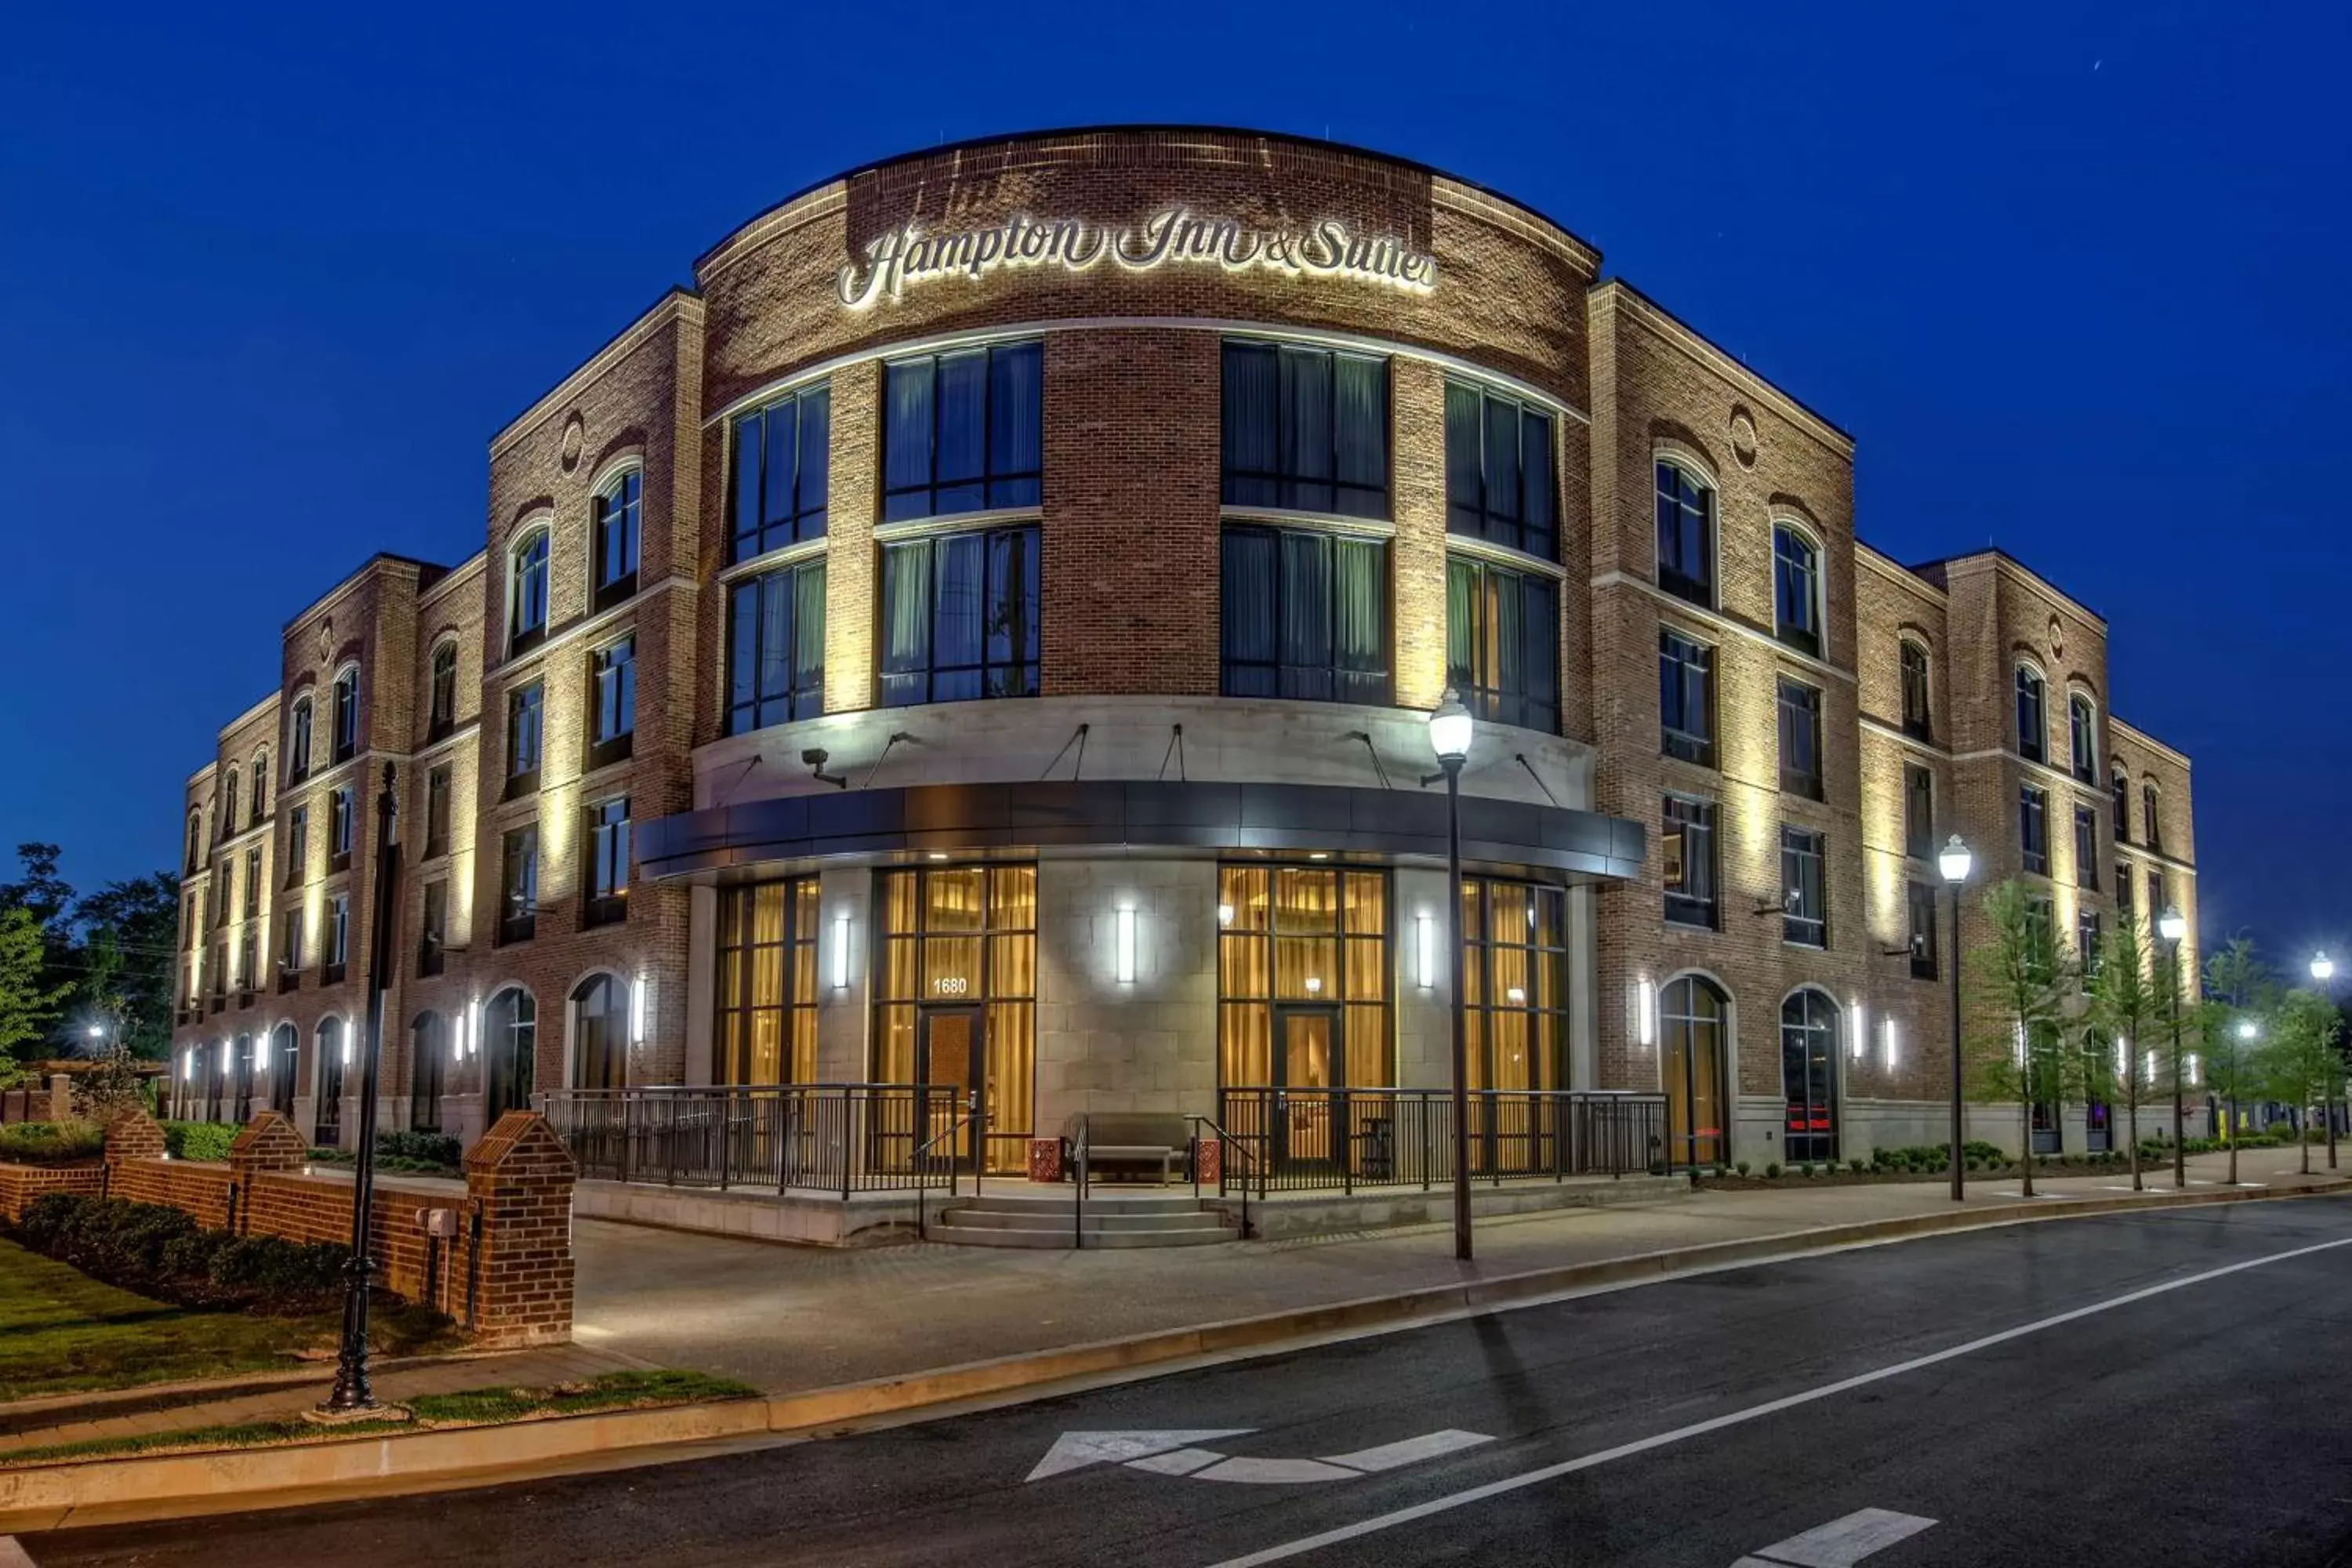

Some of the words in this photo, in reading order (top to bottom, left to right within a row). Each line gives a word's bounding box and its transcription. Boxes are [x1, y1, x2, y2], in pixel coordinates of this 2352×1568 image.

[837, 218, 1104, 305] Hampton
[1115, 206, 1262, 265] Inn
[1265, 230, 1301, 270] &
[1298, 220, 1438, 287] Suites
[934, 978, 967, 994] 1680
